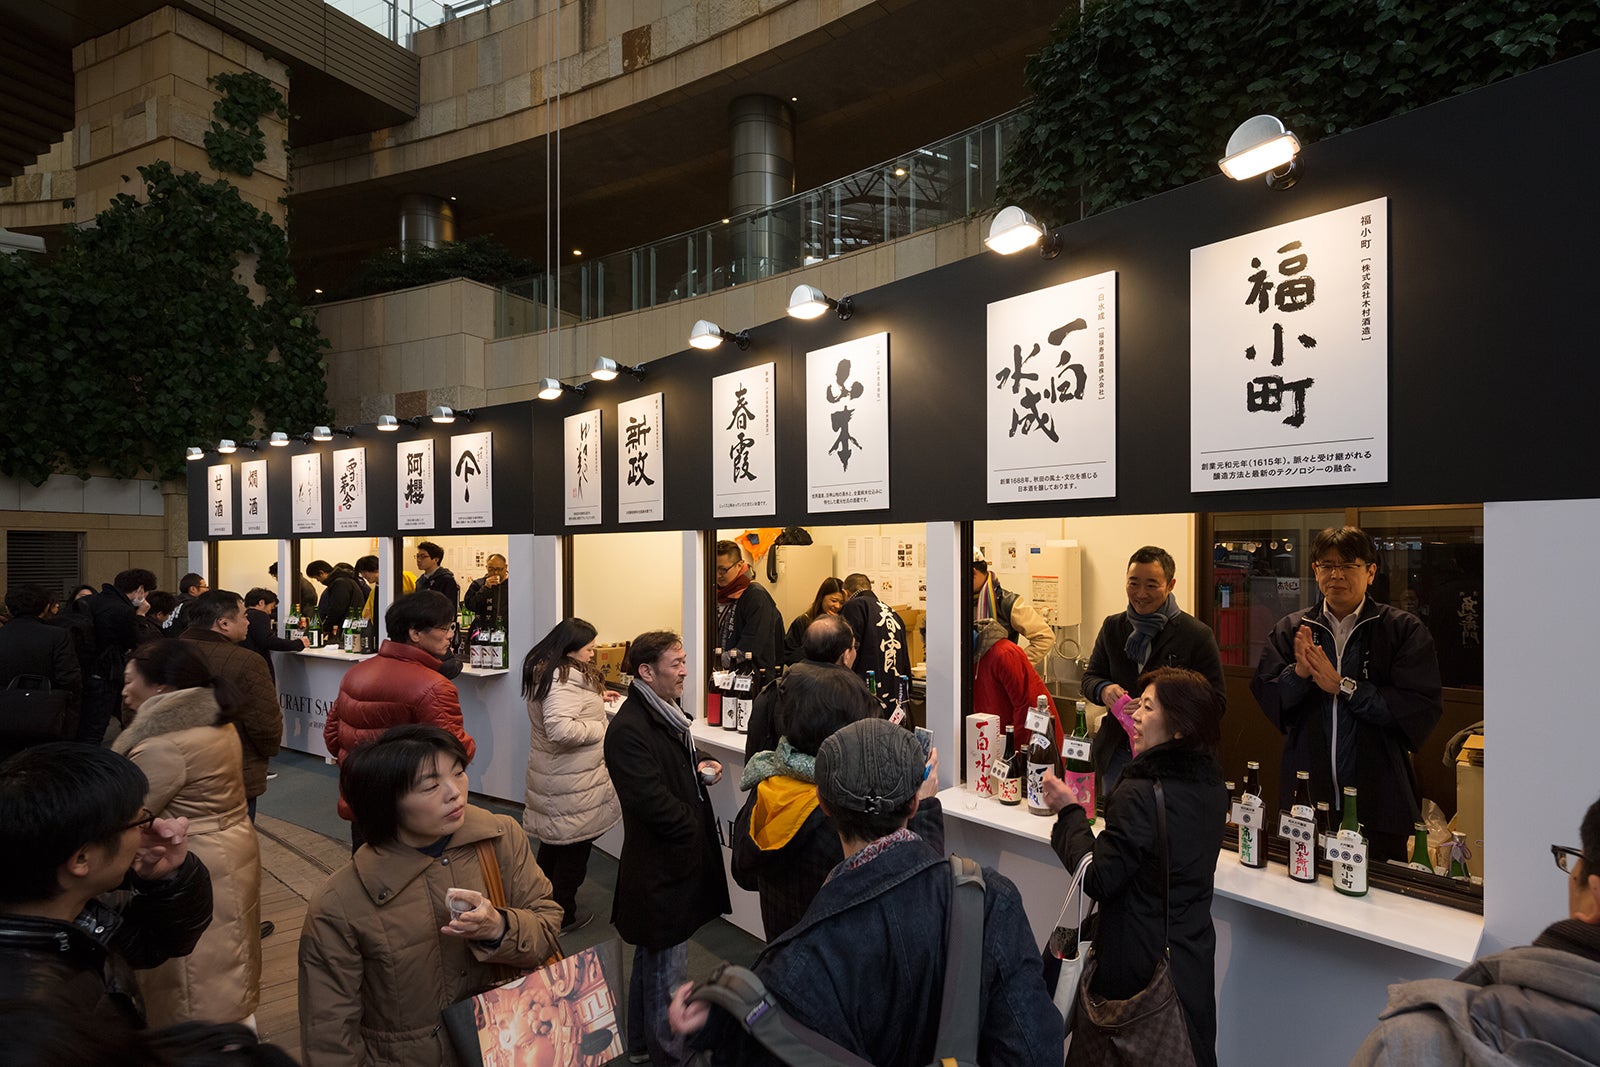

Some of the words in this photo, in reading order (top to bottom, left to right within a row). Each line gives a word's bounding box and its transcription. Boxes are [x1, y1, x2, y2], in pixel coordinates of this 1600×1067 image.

[1361, 214, 1372, 250] 福小町
[1245, 240, 1318, 429] 福小町
[625, 414, 656, 487] 新政
[726, 382, 757, 483] 春霞
[826, 358, 865, 473] 山本
[214, 474, 224, 517] 甘酒
[280, 693, 312, 713] CRAFT
[975, 721, 993, 795] 一白水成
